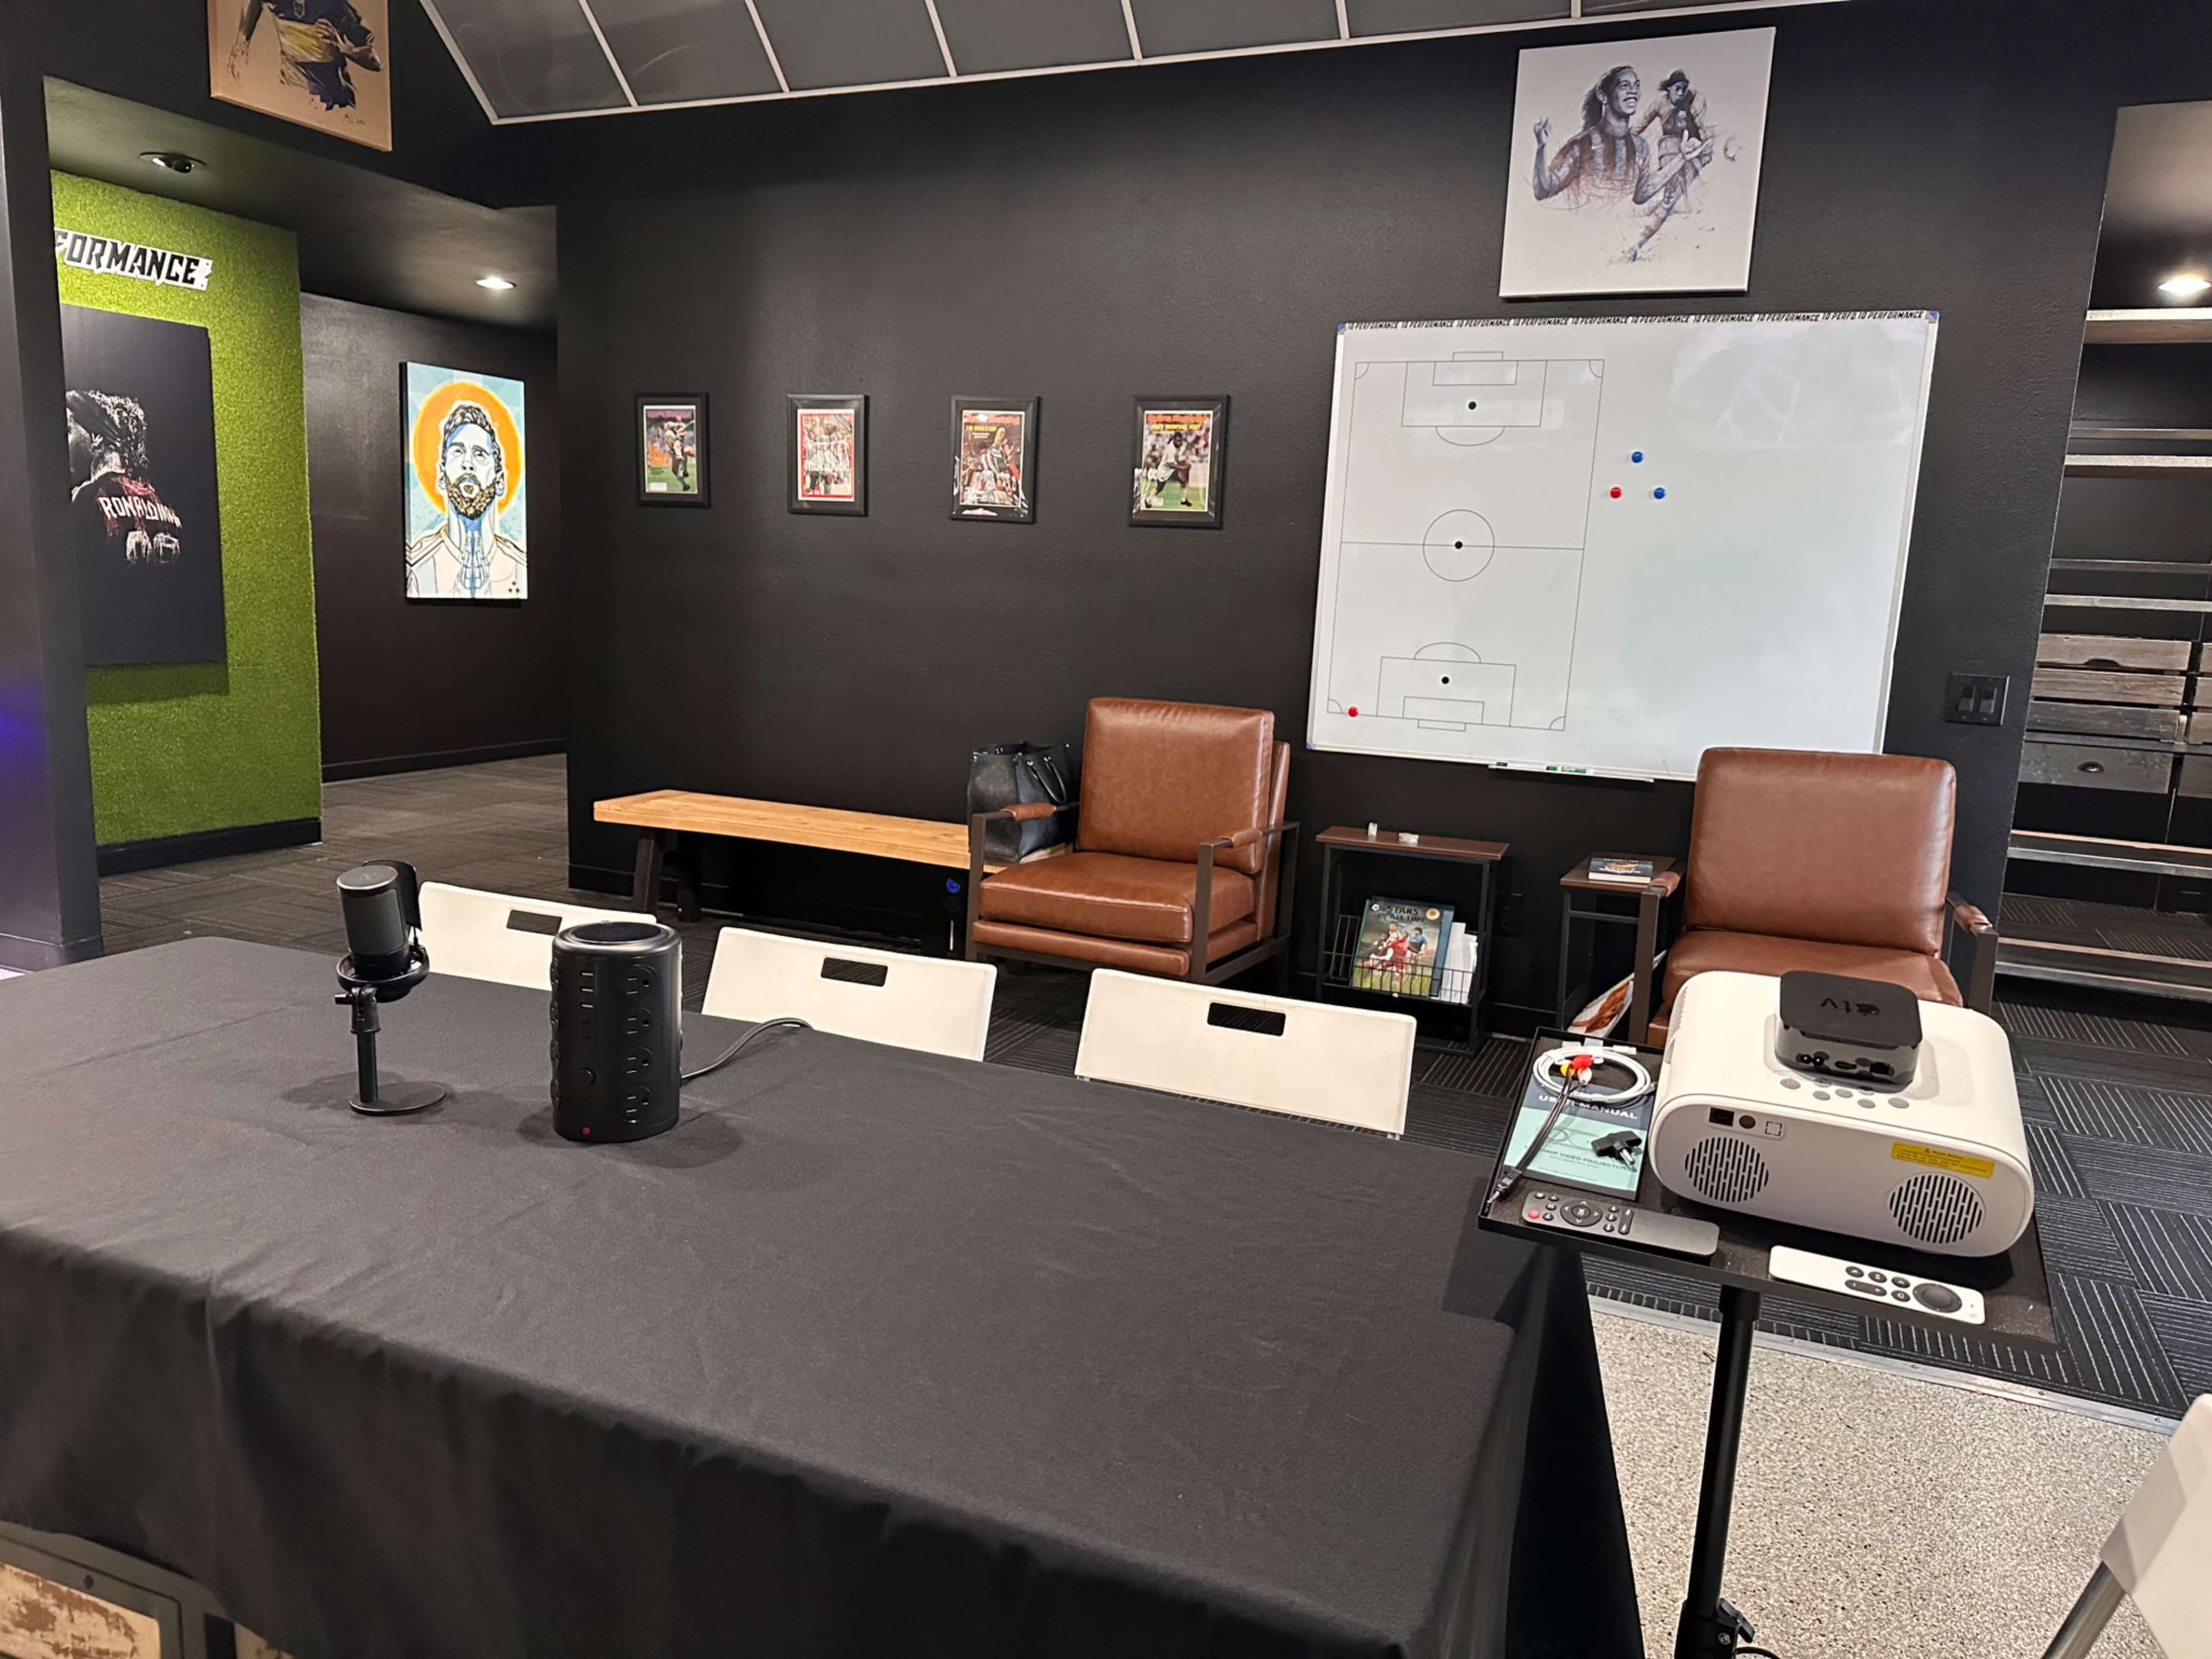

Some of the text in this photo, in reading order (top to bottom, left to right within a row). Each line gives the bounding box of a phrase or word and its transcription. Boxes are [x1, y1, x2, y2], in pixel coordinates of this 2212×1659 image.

[1539, 1094, 1638, 1119] USR MANUAL
[1560, 1152, 1582, 1160] VIDEO
[1583, 1158, 1627, 1171] PROJECTOR
